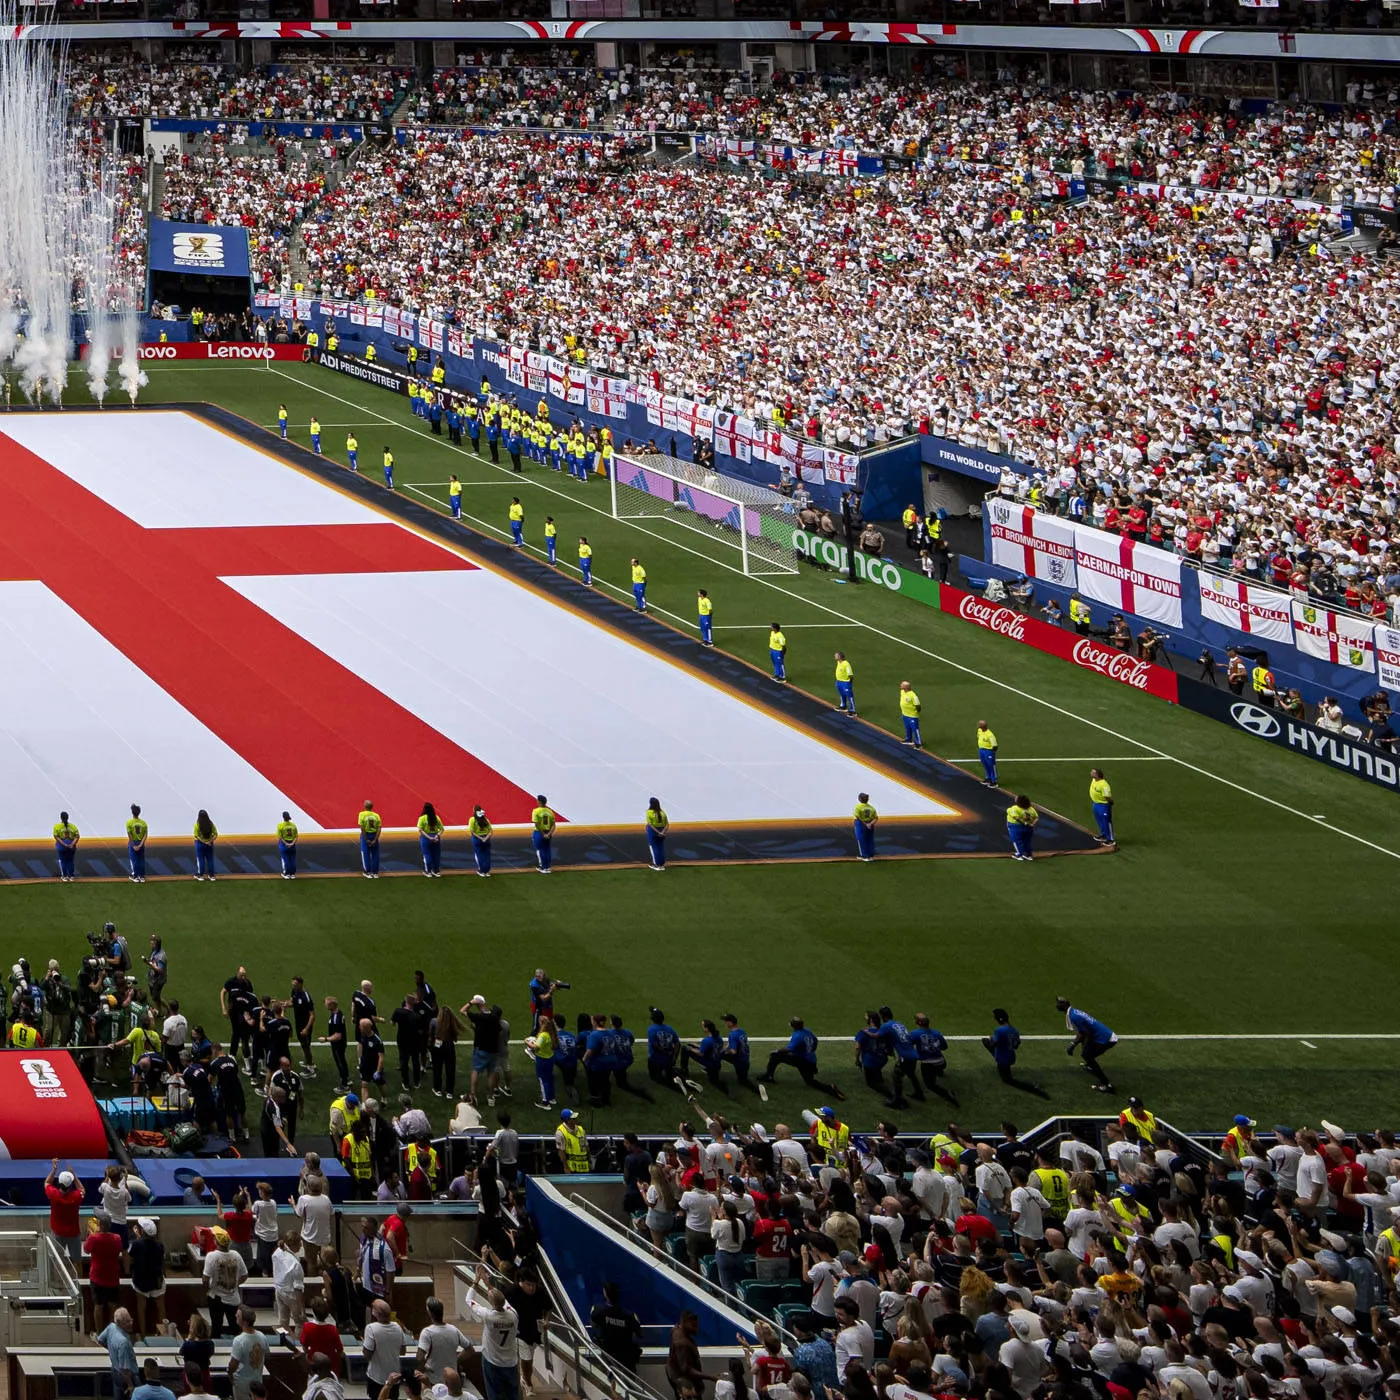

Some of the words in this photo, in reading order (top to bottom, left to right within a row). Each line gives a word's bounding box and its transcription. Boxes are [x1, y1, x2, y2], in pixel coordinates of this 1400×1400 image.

[112, 344, 177, 359] Lnovo
[207, 343, 276, 359] Lenovo
[482, 349, 500, 365] FIFA
[319, 352, 339, 371] ADI
[340, 360, 401, 390] PREDICTSTREET
[939, 450, 956, 461] FIFA
[956, 454, 984, 470] WORLD
[984, 463, 1001, 475] CUP
[1005, 530, 1046, 551] BROMWICH
[1077, 551, 1145, 587] CAERNARFON
[1149, 576, 1180, 596] TOWN
[1202, 587, 1256, 615] CANNOCK
[1257, 606, 1289, 622] VILLA
[958, 594, 1026, 641] Coca-Cola
[1301, 623, 1366, 649] WISBECH
[1072, 638, 1151, 690] Coca-Cola
[1288, 722, 1400, 786] HYUND
[772, 1235, 788, 1252] 24
[498, 1330, 510, 1347] 7
[769, 1369, 783, 1384] 14
